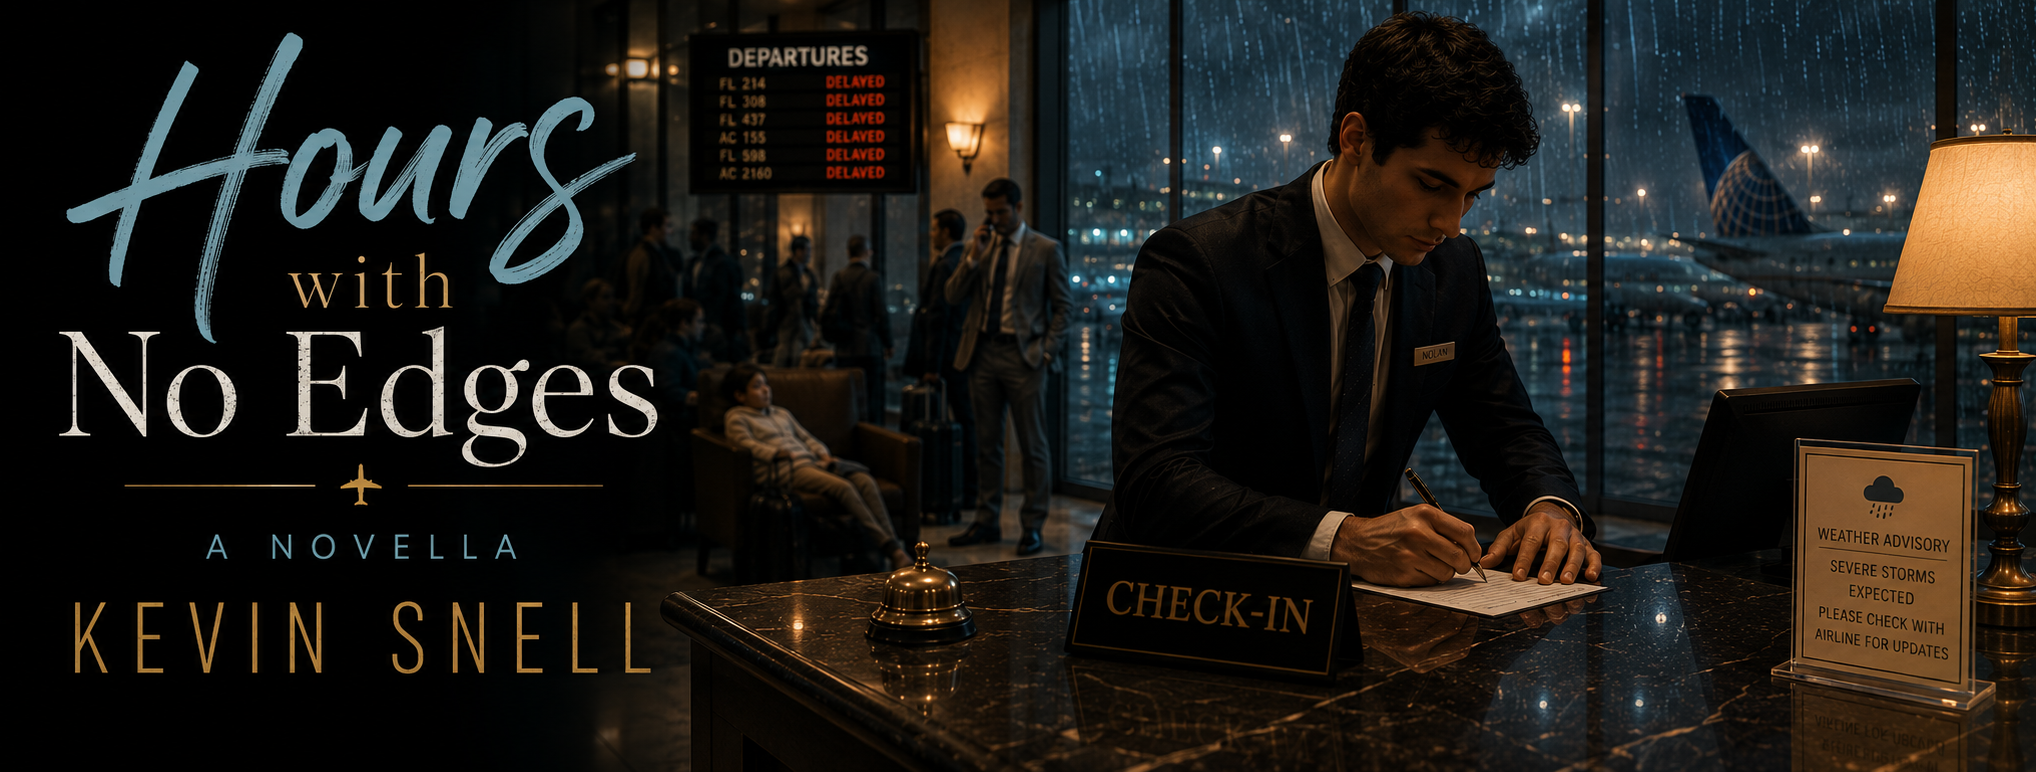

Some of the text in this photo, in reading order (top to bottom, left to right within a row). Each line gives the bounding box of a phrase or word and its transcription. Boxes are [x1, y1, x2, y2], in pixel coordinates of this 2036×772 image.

[728, 45, 869, 68] DEPARTURES
[719, 75, 885, 91] FL 214 DELAYED
[719, 93, 885, 108] FL 308 DELAYED
[719, 111, 885, 126] FL 437 DELAYED
[719, 130, 885, 144] AC 155 DELAYED
[719, 148, 885, 162] FL 598 DELAYED
[719, 166, 885, 180] AC 2160 DELAYED
[1818, 527, 1950, 553] WEATHER ADVISORY
[1830, 560, 1935, 584] SEVERE STORMS
[1849, 584, 1914, 605] EXPECTED
[1106, 580, 1313, 635] CHECK-IN
[1819, 606, 1944, 635] PLEASE CHECK WITH
[1815, 628, 1949, 660] AIRLINE FOR UPDATES
